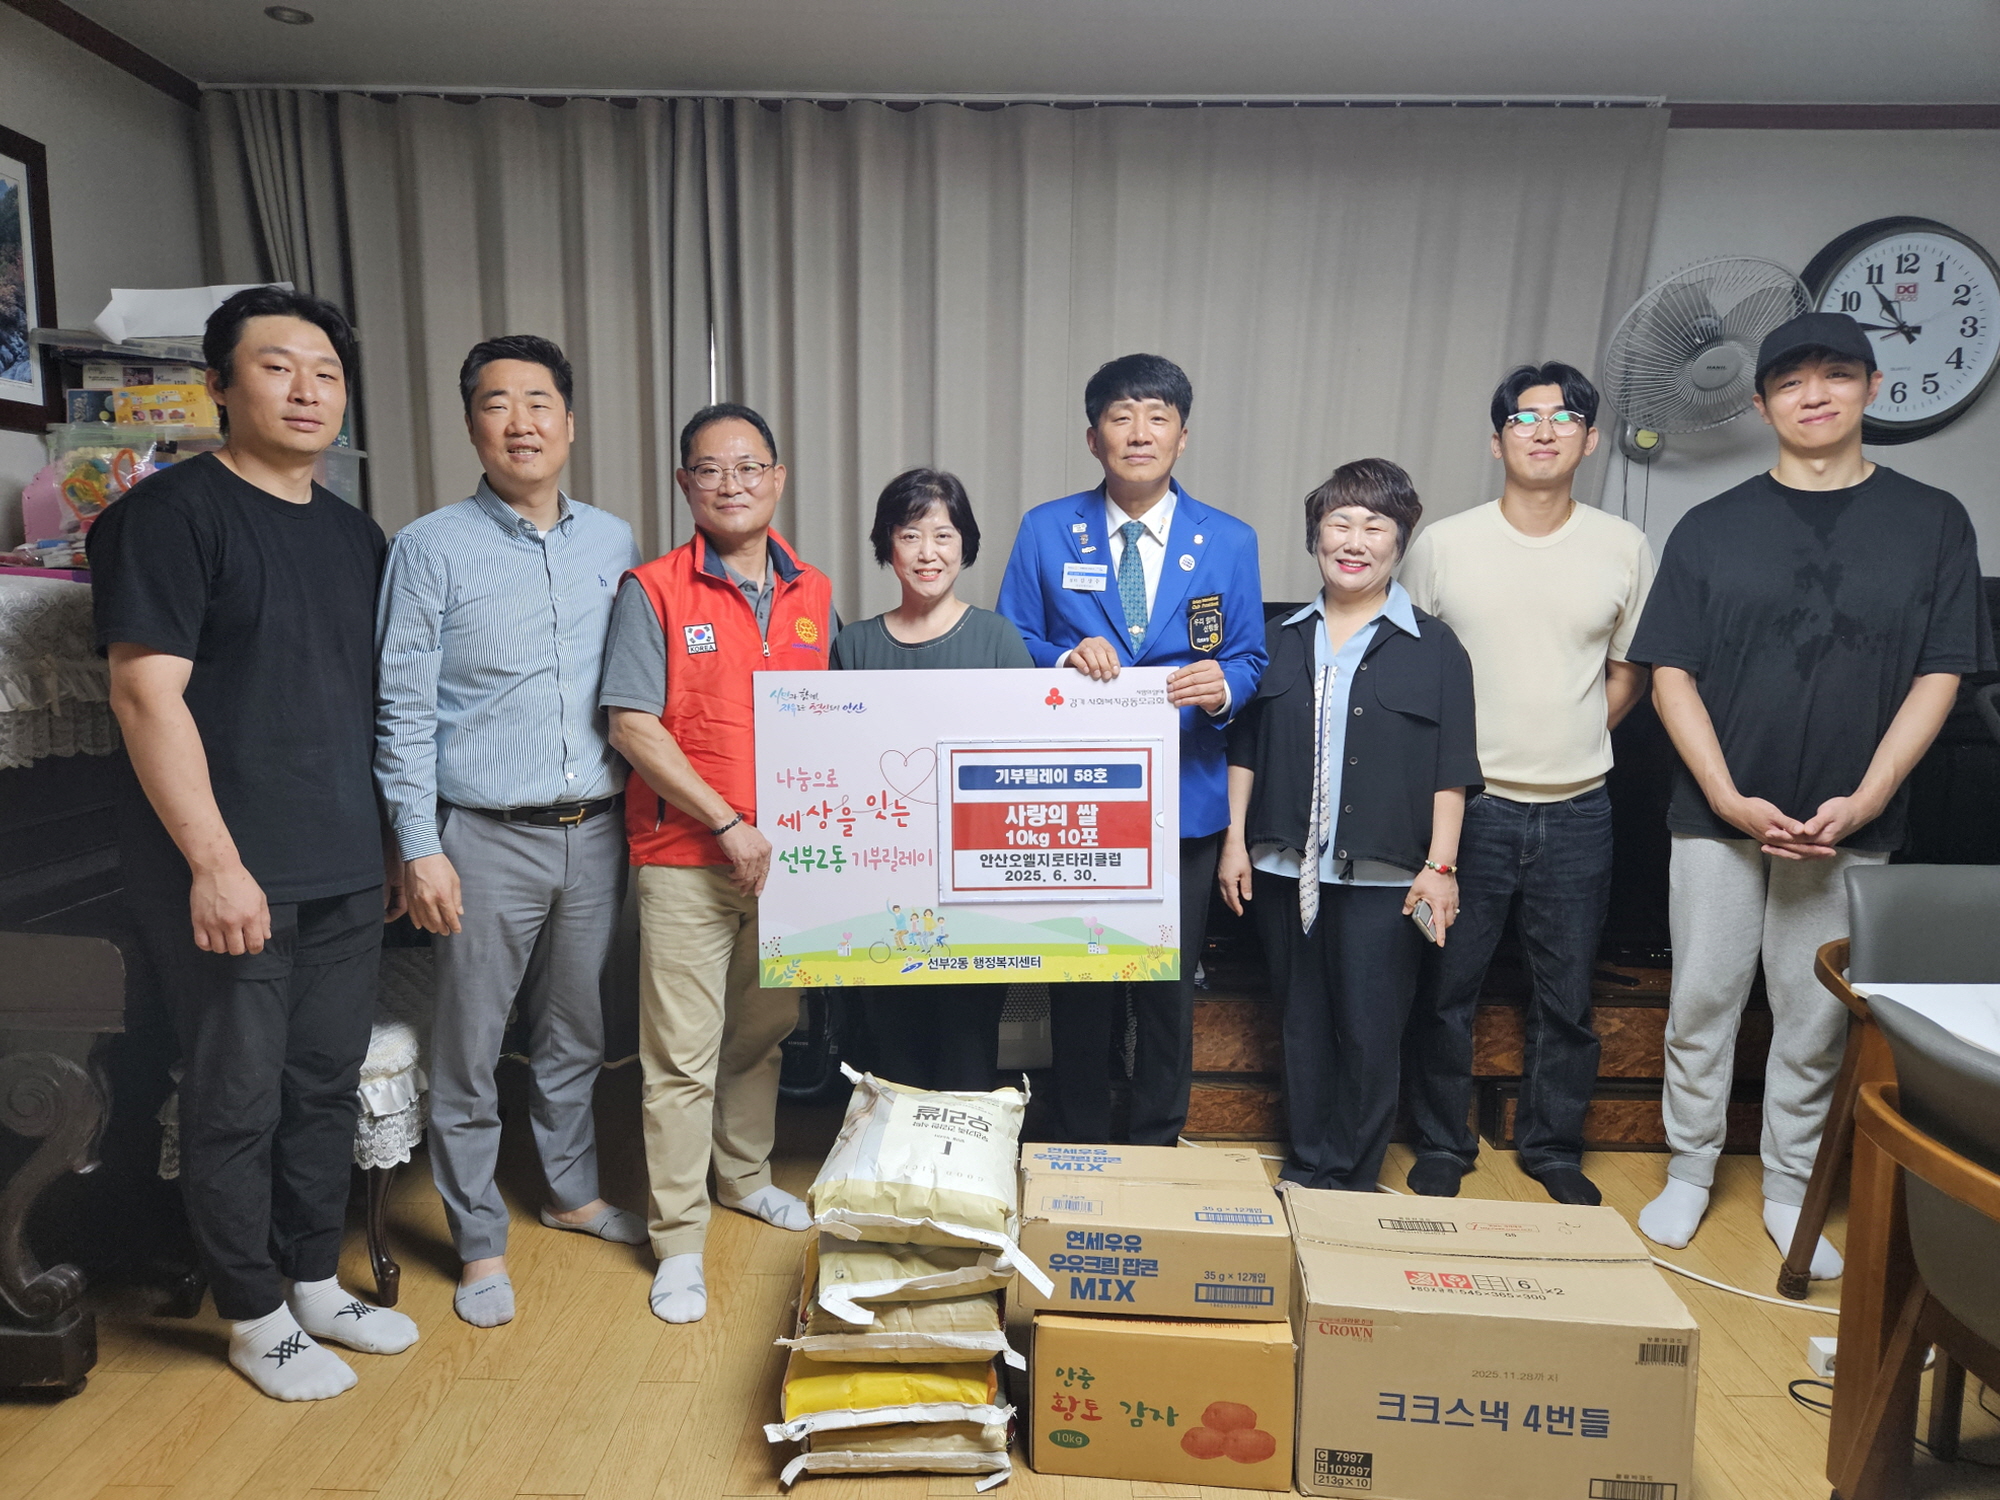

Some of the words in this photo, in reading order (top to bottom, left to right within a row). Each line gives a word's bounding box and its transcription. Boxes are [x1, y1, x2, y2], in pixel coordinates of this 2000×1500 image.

[1865, 263, 1884, 285] 11
[1895, 252, 1921, 274] 12
[1934, 261, 1946, 283] 1
[1840, 291, 1862, 312] 10
[1952, 284, 1972, 306] 2
[1960, 316, 1979, 338] 3
[1945, 347, 1965, 370] 4
[1890, 381, 1908, 404] 6
[1921, 372, 1940, 395] 5
[690, 644, 715, 653] KOREA
[842, 702, 867, 714] 안산
[776, 767, 839, 793] 나눔으로
[995, 767, 1068, 785] 기부릴레이
[1073, 767, 1108, 784] 58호
[776, 799, 857, 838] 세상을
[866, 789, 911, 828] 잇는
[1004, 803, 1068, 827] 사랑의
[1076, 803, 1099, 826] 쌀
[1005, 829, 1050, 848] 10kg
[1057, 827, 1099, 847] 10포
[778, 844, 847, 875] 선부2동
[851, 845, 933, 873] 기부릴레이
[979, 852, 1122, 868] 안산오엘지로타리클럽
[1004, 869, 1047, 882] 2025.
[1053, 869, 1067, 882] 6.
[1073, 869, 1097, 882] 30.
[927, 956, 969, 970] 선부2동
[973, 955, 1041, 969] 행정복지센터
[912, 1105, 993, 1133] 우리쌀
[1047, 1147, 1108, 1156] 연세우유
[1050, 1161, 1104, 1172] MIX
[1066, 1230, 1142, 1253] 연세우유
[1048, 1253, 1120, 1276] 우유크림
[1122, 1258, 1159, 1278] 팝콘
[1204, 1270, 1216, 1280] 35
[1218, 1273, 1225, 1283] g
[1237, 1272, 1266, 1284] 12개입
[1517, 1280, 1531, 1290] 6
[1070, 1276, 1136, 1303] MIX
[1318, 1322, 1373, 1338] CROWN
[1055, 1367, 1095, 1390] 안중
[1051, 1392, 1103, 1422] 황토
[1119, 1401, 1180, 1428] 감자
[1376, 1392, 1510, 1432] 크크스낵
[1522, 1404, 1610, 1439] 4번들
[1056, 1432, 1083, 1445] 10kg
[1317, 1450, 1327, 1460] C
[1335, 1451, 1364, 1464] 7997
[1317, 1462, 1326, 1472] H
[1329, 1463, 1371, 1477] 107997
